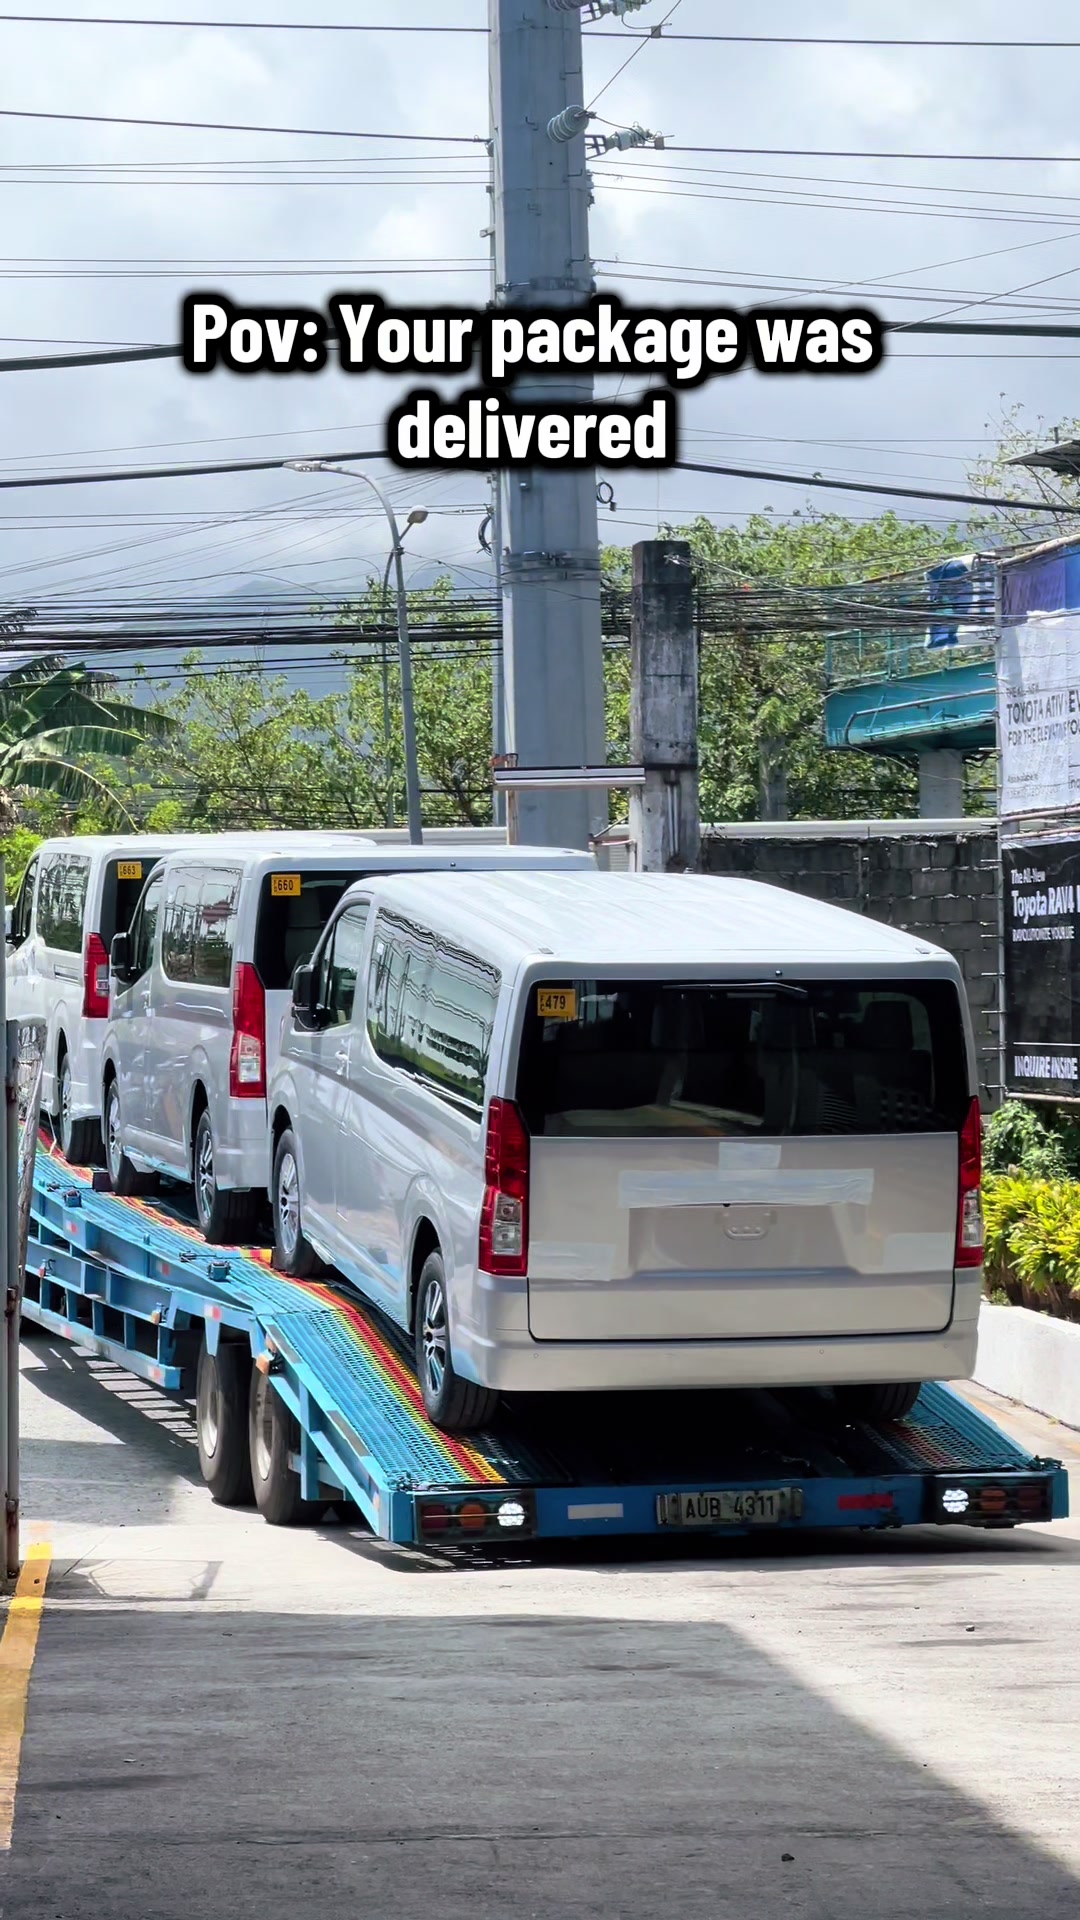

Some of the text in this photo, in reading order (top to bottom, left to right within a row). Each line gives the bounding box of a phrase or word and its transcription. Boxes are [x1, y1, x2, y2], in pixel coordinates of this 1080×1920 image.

[1006, 699, 1044, 726] TOYOTA
[1045, 693, 1064, 719] ATIV
[277, 879, 294, 891] 660
[1011, 869, 1023, 884] The
[1011, 889, 1047, 925] Toyota
[1048, 885, 1074, 915] RAV4
[545, 995, 566, 1010] 479
[1014, 1055, 1078, 1080] INQUIRE INSIDE
[685, 1495, 774, 1519] AUB 4311
